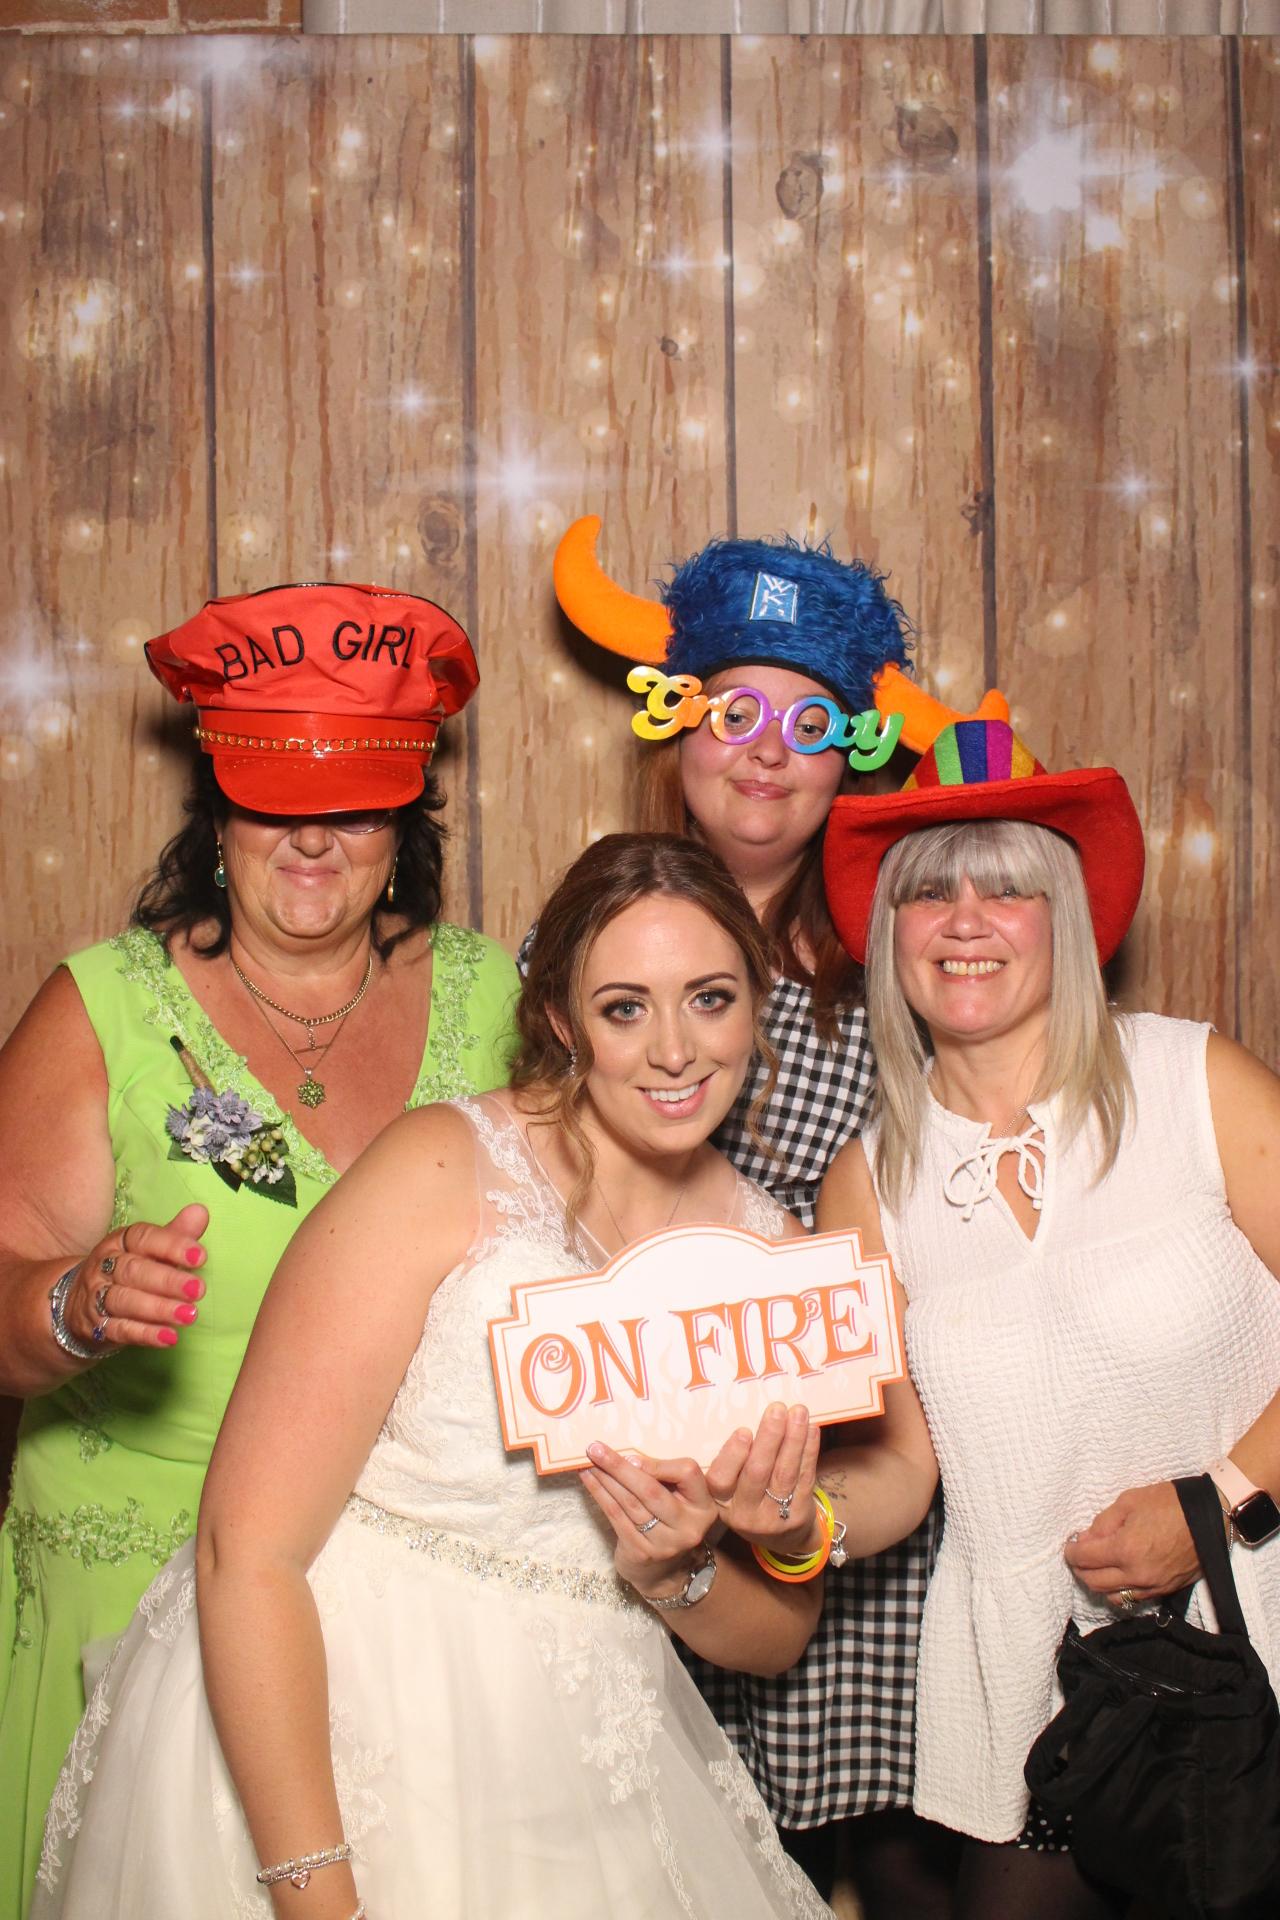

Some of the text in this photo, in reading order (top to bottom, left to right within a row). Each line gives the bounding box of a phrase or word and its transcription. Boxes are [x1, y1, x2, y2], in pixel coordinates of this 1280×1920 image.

[214, 621, 416, 681] BAD GIRL
[520, 1279, 878, 1419] ON FIRE
